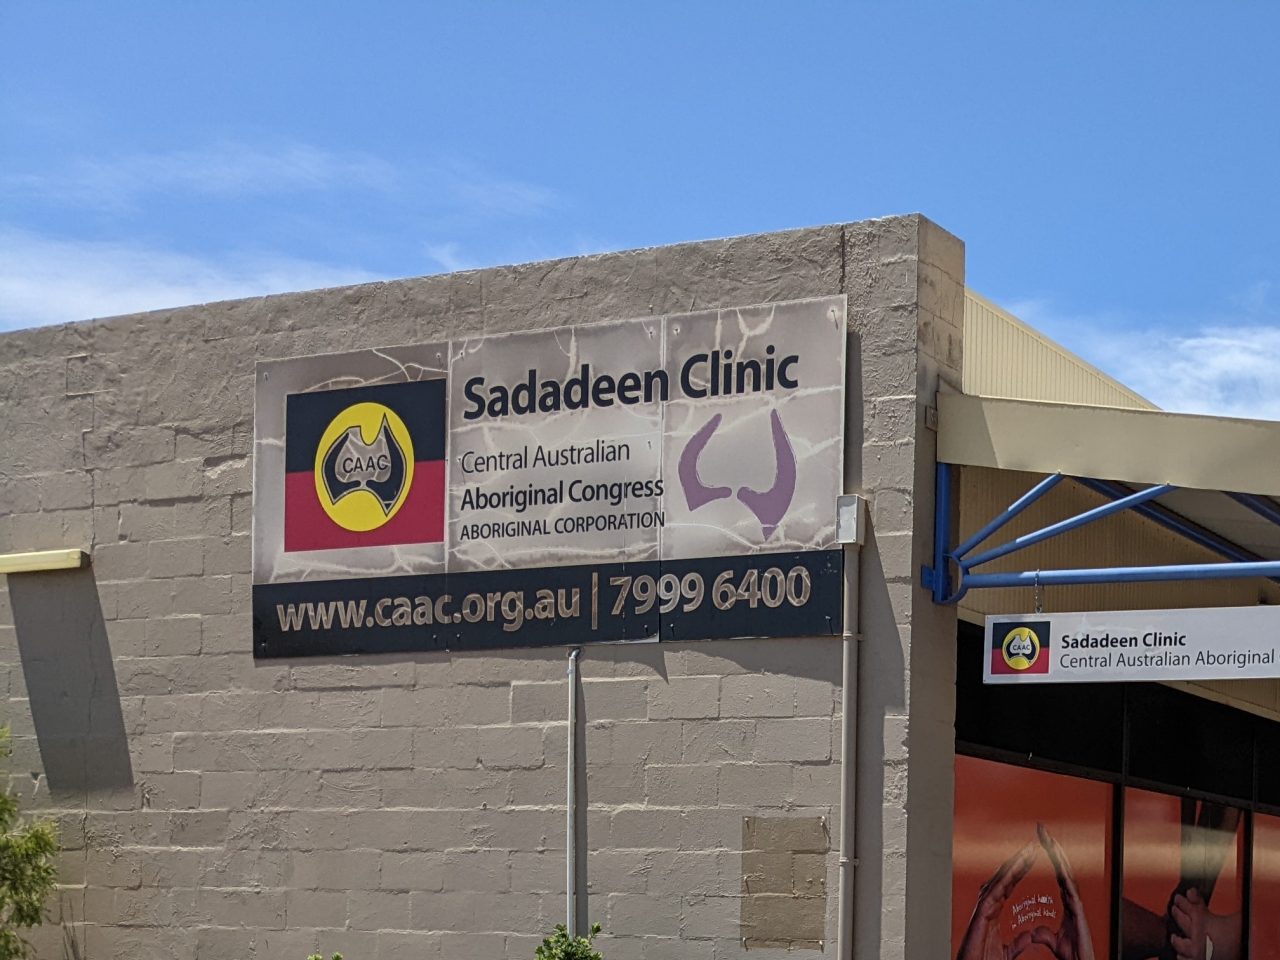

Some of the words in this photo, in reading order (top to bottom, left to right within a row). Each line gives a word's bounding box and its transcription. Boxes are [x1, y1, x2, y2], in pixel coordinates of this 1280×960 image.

[463, 364, 669, 420] Sadadeen
[680, 345, 799, 399] Clinic
[343, 454, 389, 474] CAAC
[461, 446, 528, 474] Central
[532, 439, 630, 468] Australian
[460, 479, 564, 512] Aboriginal
[568, 478, 664, 506] Congress
[460, 514, 551, 541] ABORIGINAL
[554, 511, 665, 535] CORPORATION
[277, 587, 581, 632] www.caac.org.au
[611, 573, 706, 616] 7999
[713, 565, 811, 610] 6400
[1012, 644, 1031, 652] CAAC
[1061, 633, 1137, 649] Sadadeen
[1142, 631, 1186, 648] Clinic
[1060, 654, 1111, 669] Central
[1116, 652, 1190, 668] Australian
[1195, 648, 1274, 669] Aboriginal
